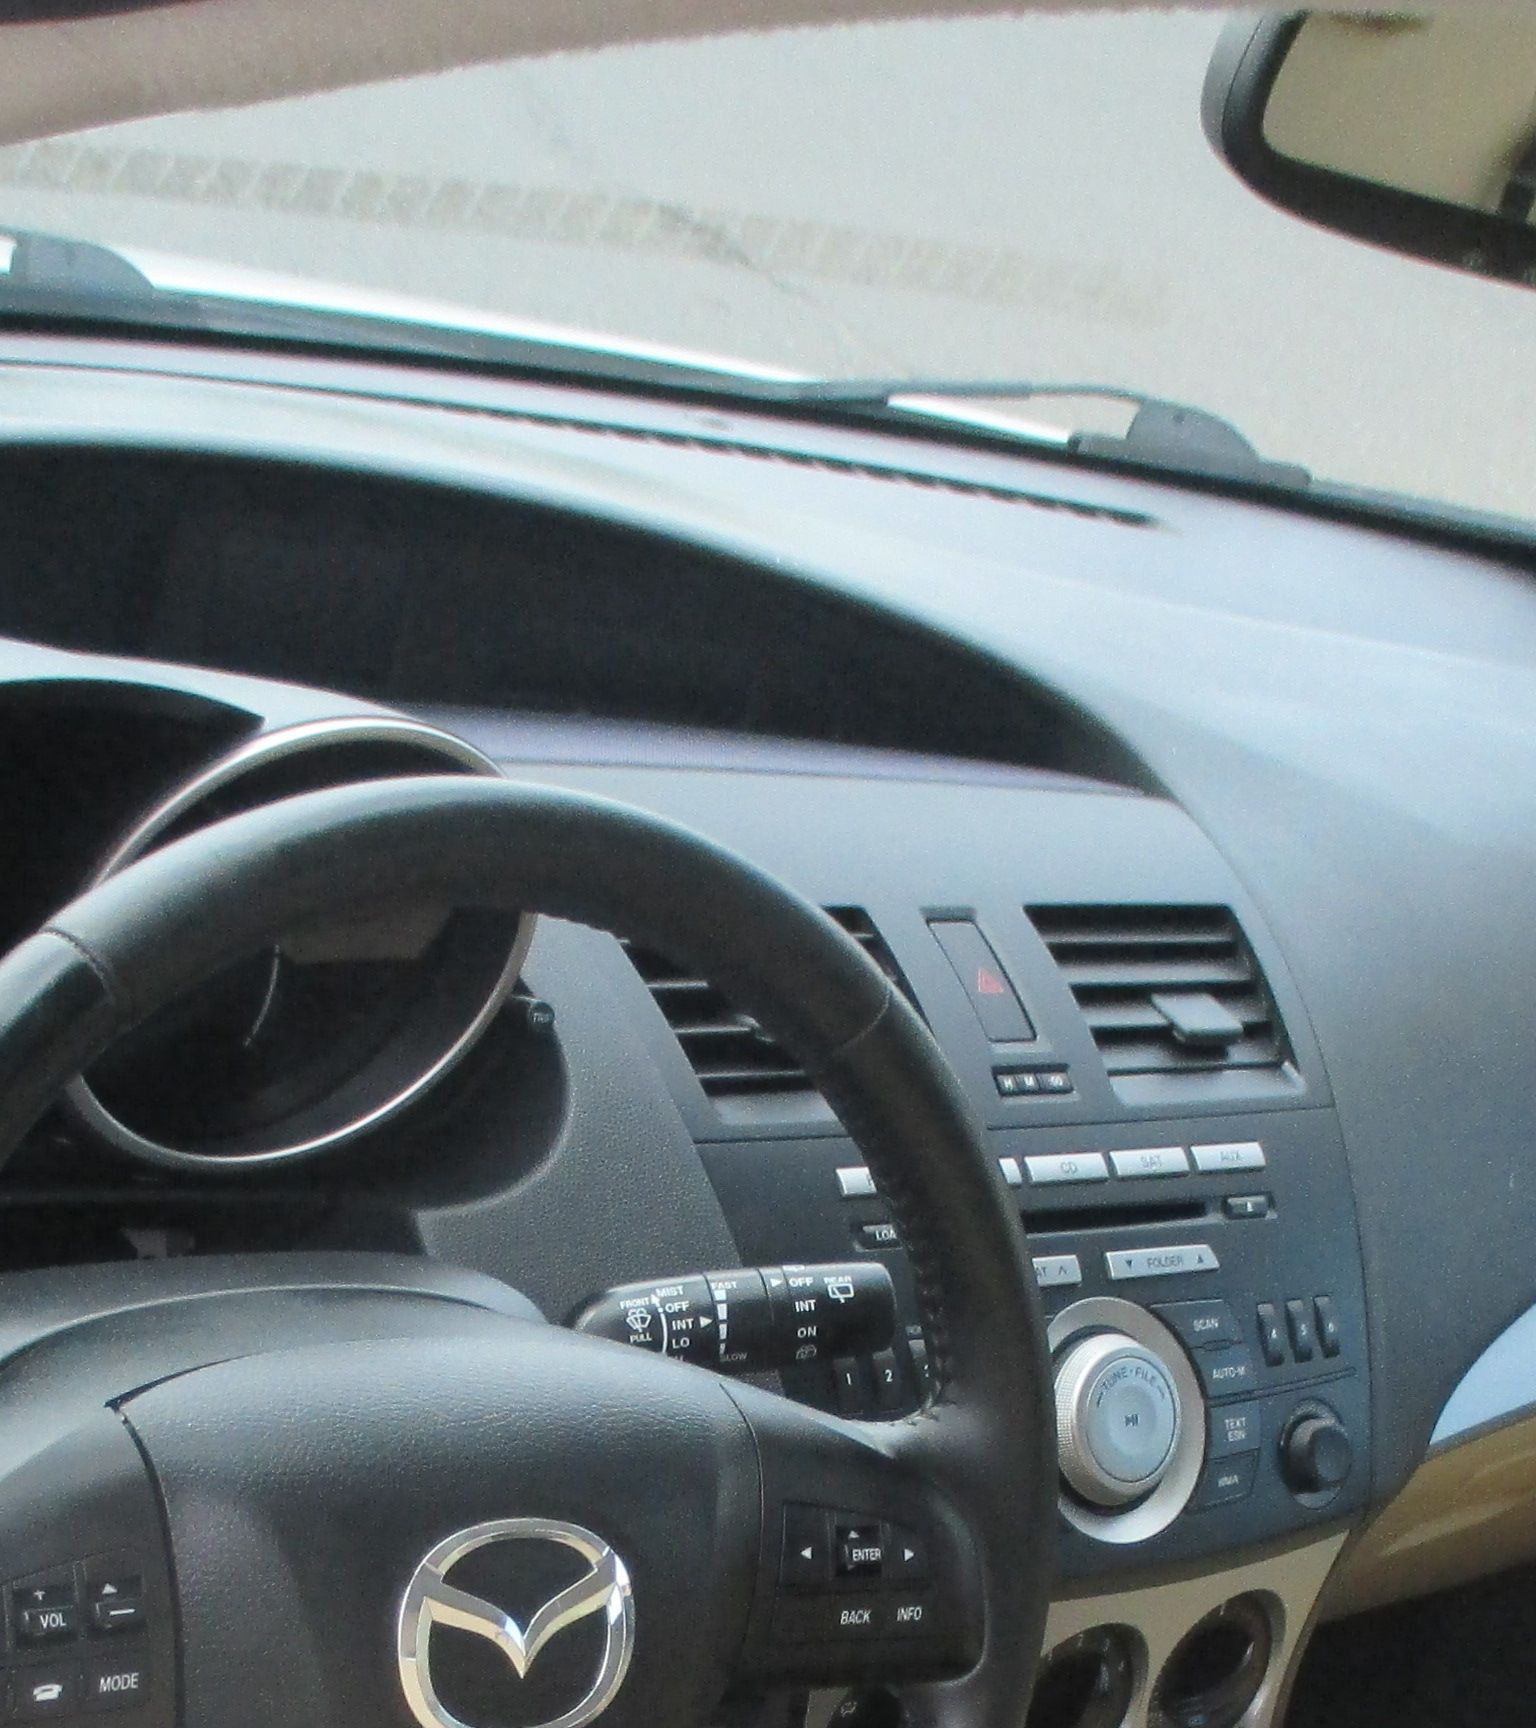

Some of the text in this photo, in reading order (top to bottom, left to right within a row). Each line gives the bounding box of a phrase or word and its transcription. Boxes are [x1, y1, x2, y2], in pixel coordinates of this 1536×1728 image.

[1146, 1256, 1185, 1268] FOLDER
[711, 1280, 737, 1290] FAST
[789, 1276, 814, 1288] OFF
[655, 1285, 684, 1298] MIST
[619, 1297, 650, 1309] FRONT
[665, 1301, 690, 1313] OFF
[795, 1299, 817, 1313] INT
[672, 1318, 694, 1331] INT
[1193, 1317, 1219, 1332] SCAN
[629, 1332, 653, 1344] PULL
[797, 1326, 817, 1339] ON
[672, 1337, 690, 1349] LO
[884, 1369, 894, 1383] 2
[1224, 1416, 1247, 1431] TEXT
[852, 1547, 881, 1562] ENTER
[40, 1612, 67, 1629] VOL
[840, 1609, 872, 1625] BACK
[897, 1606, 923, 1622] INFO
[99, 1672, 140, 1693] MODE
